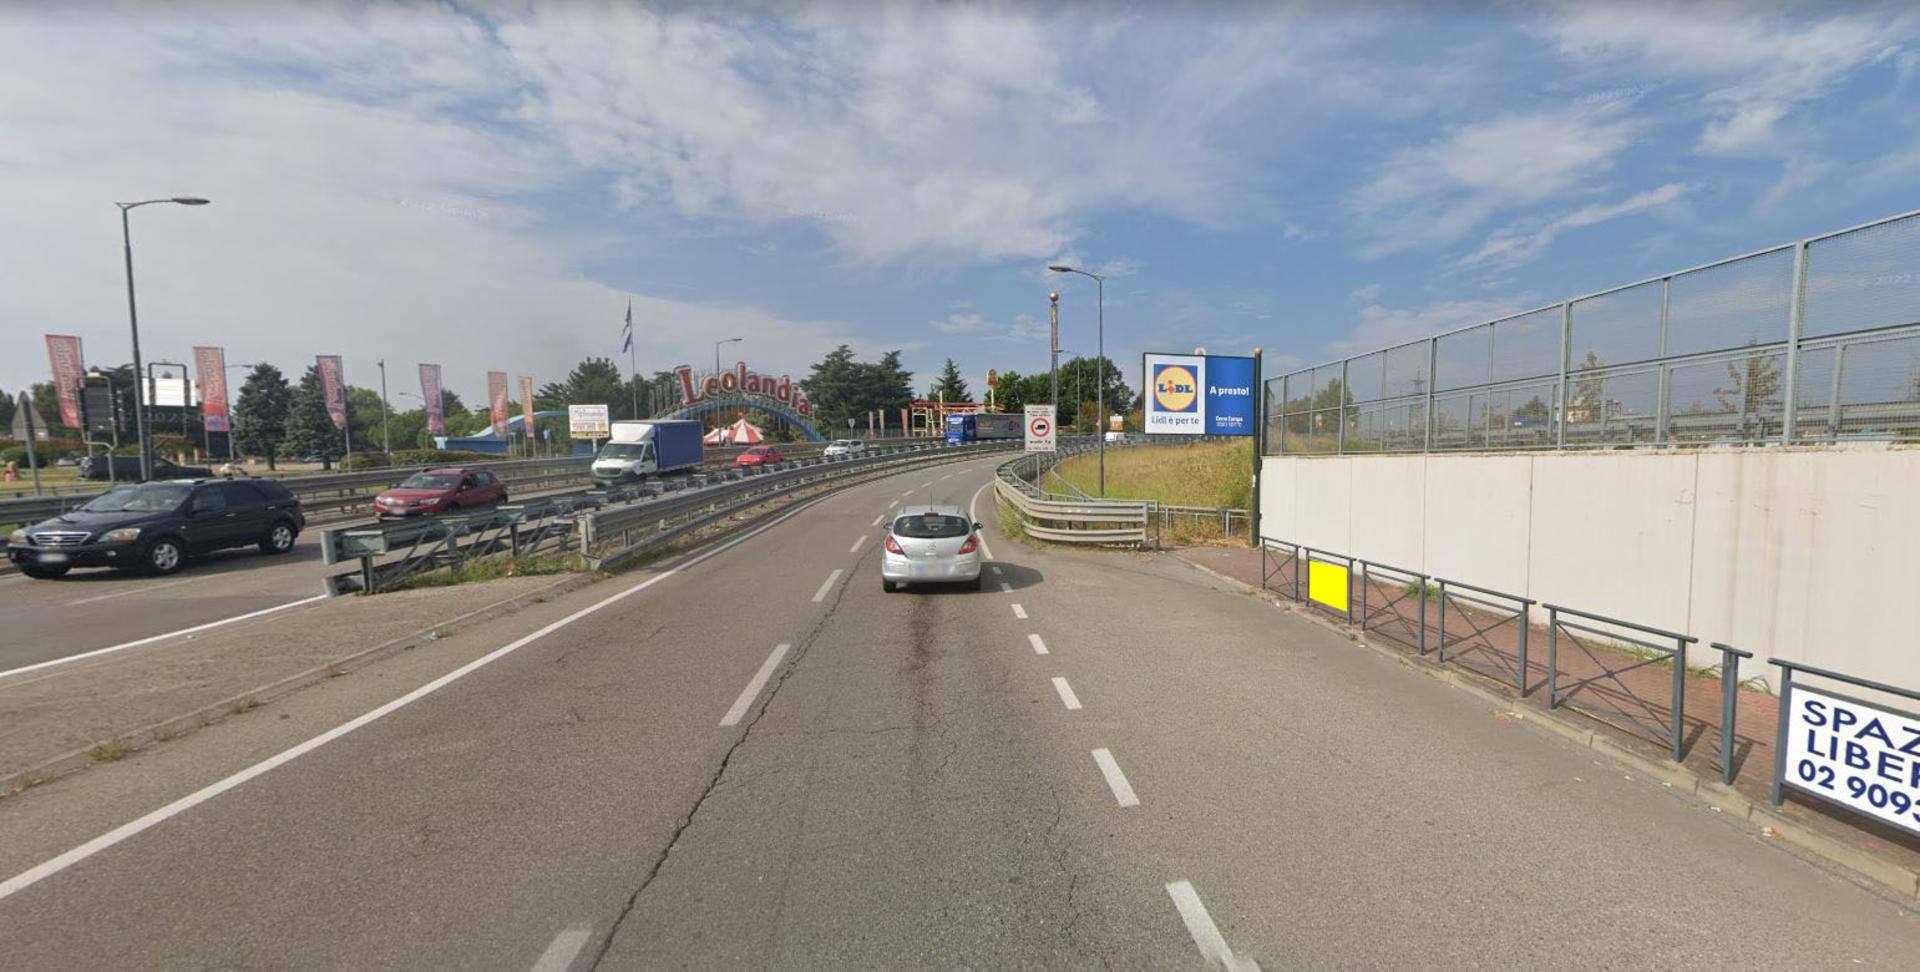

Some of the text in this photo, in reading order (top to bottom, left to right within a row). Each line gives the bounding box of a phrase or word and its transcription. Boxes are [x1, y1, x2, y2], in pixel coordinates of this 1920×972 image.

[674, 361, 811, 416] Leolandia
[1209, 386, 1249, 397] A presto!
[1151, 416, 1167, 425] Lidl
[1175, 417, 1189, 426] per
[1190, 416, 1200, 425] te
[1798, 759, 1835, 790] 02
